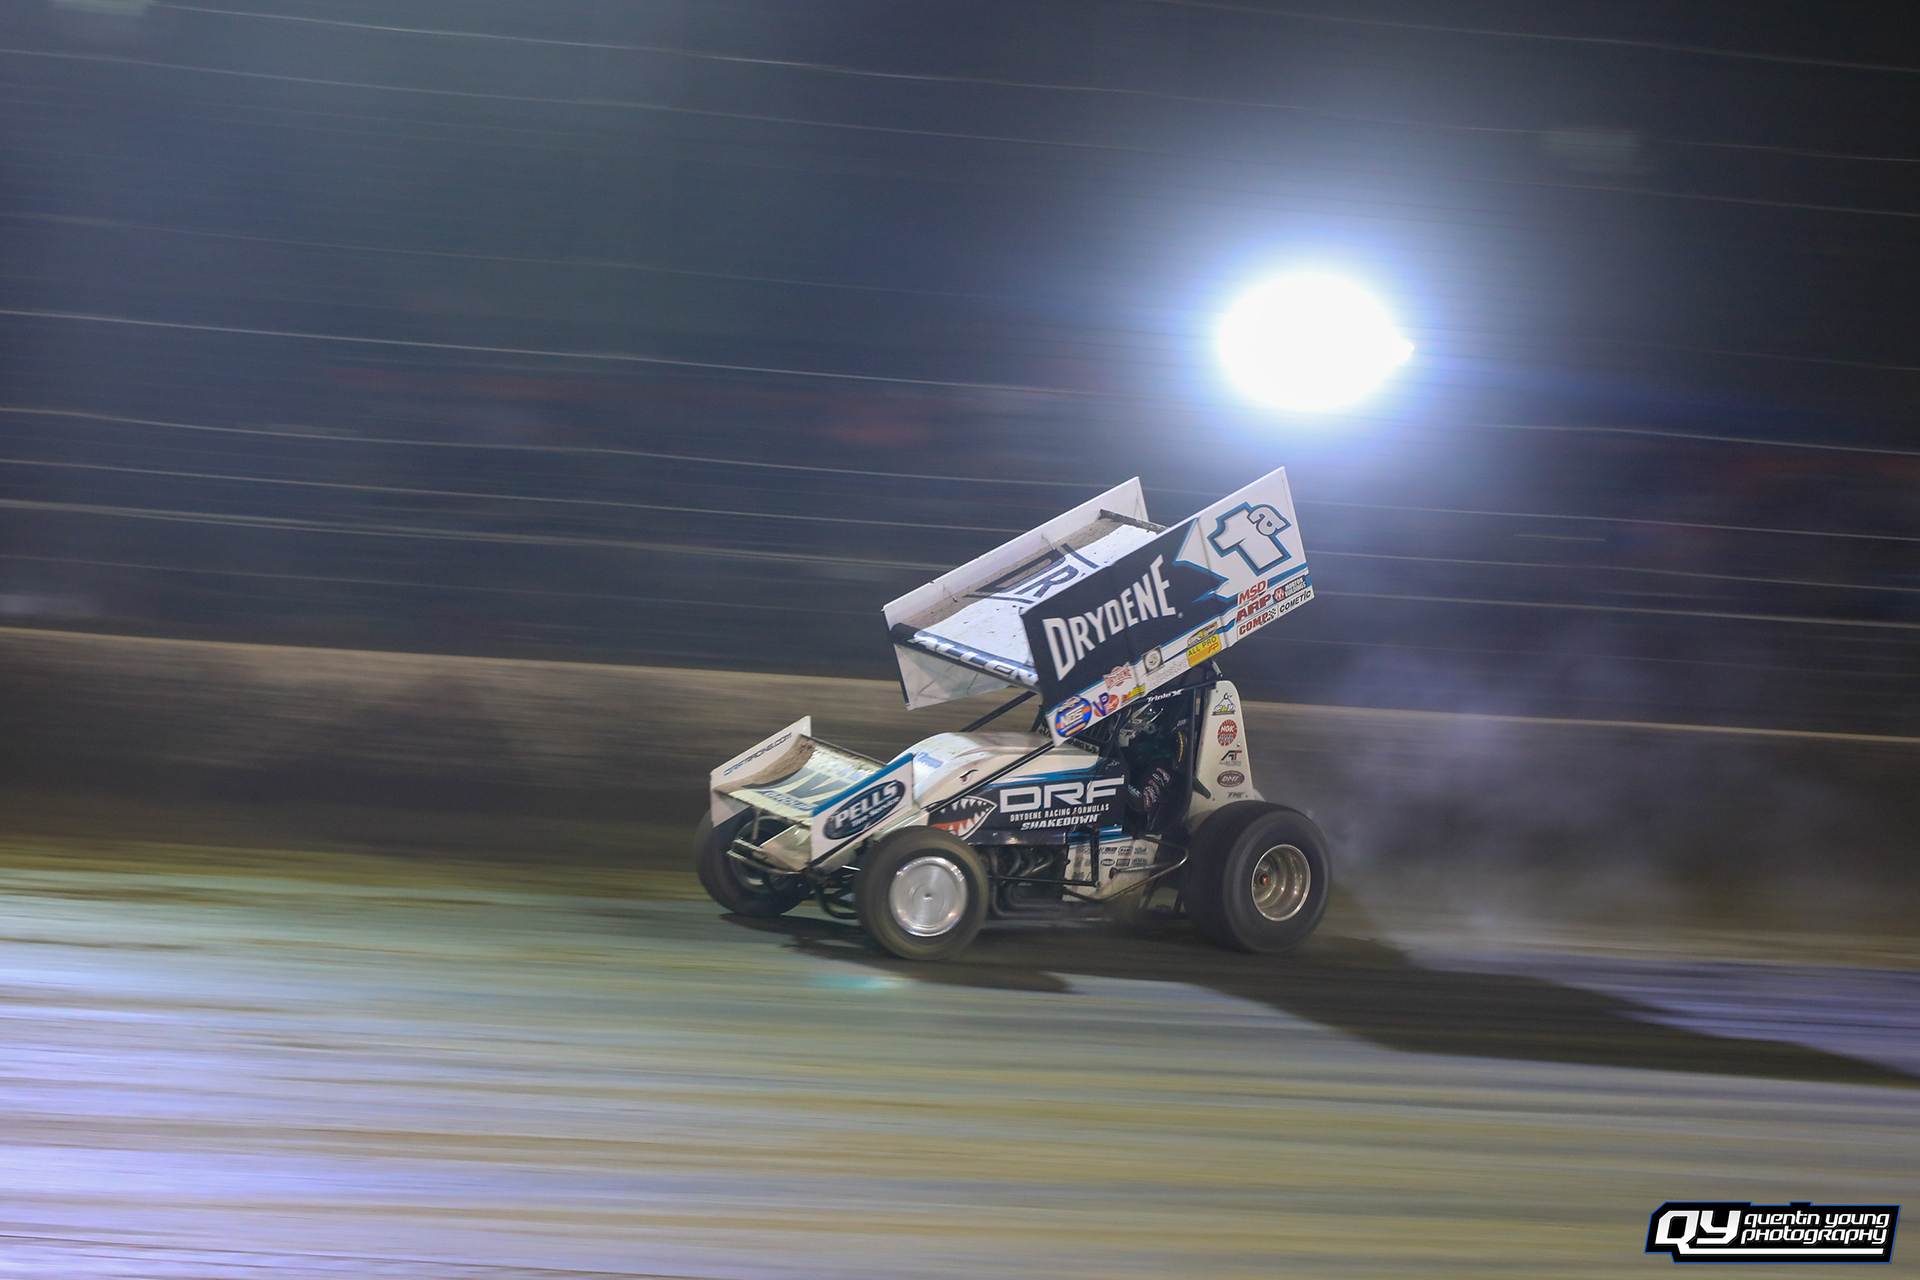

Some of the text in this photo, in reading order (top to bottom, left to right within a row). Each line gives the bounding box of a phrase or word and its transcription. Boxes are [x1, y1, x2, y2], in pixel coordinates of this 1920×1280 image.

[1239, 580, 1267, 605] MSD
[1280, 590, 1311, 618] COMETIC
[1042, 554, 1177, 681] DRYDENE
[1236, 594, 1271, 622] ARP
[1239, 612, 1268, 635] COMP
[1188, 636, 1216, 656] ALL PRO
[1093, 692, 1109, 716] VP
[835, 781, 898, 829] PELLS
[1000, 777, 1124, 813] DRF
[1010, 803, 1110, 822] DRYDENE RACING FORMULAS
[1021, 814, 1098, 830] SHAKEDOWN
